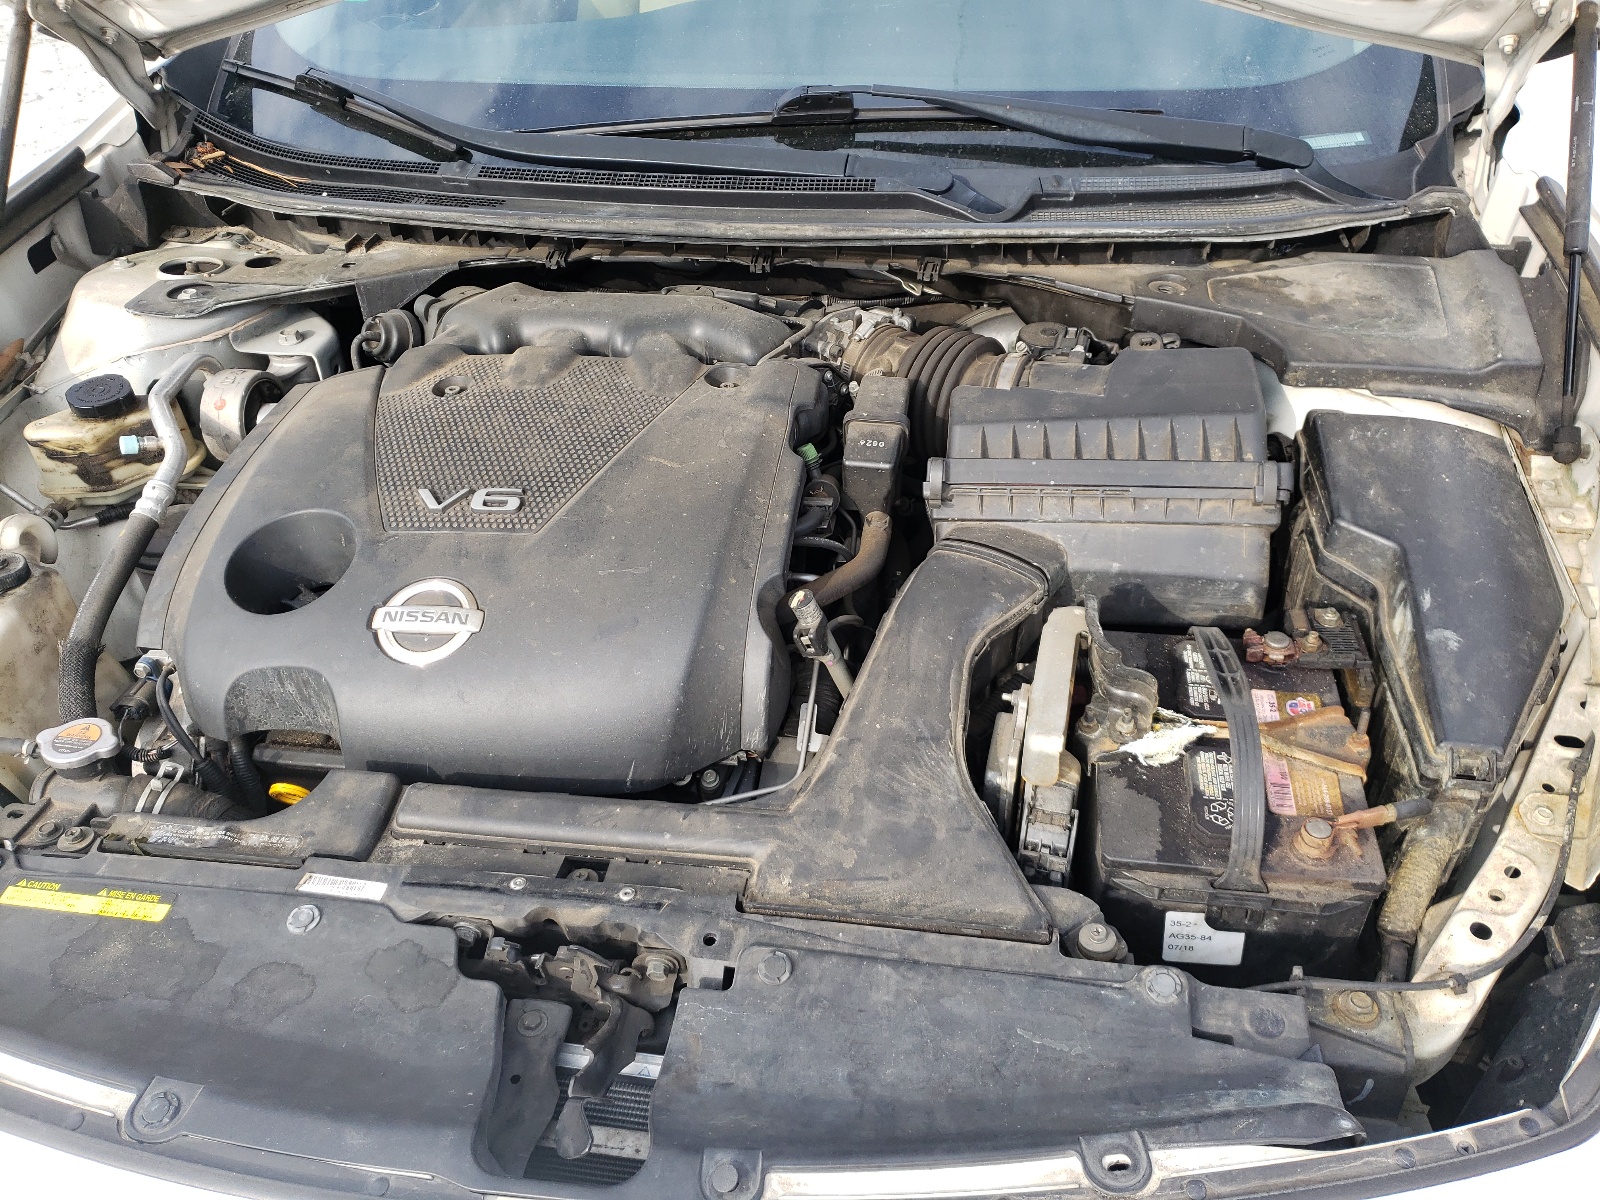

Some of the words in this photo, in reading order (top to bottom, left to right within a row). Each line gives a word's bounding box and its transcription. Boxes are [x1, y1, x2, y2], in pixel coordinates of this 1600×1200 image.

[417, 487, 526, 514] V6
[382, 610, 470, 625] NISSAN
[27, 880, 62, 891] CAUTION
[108, 890, 126, 899] MISE
[125, 892, 137, 900] EN
[136, 893, 161, 902] GARDE
[1168, 932, 1212, 941] AG35-84
[1167, 943, 1194, 951] 07/18
